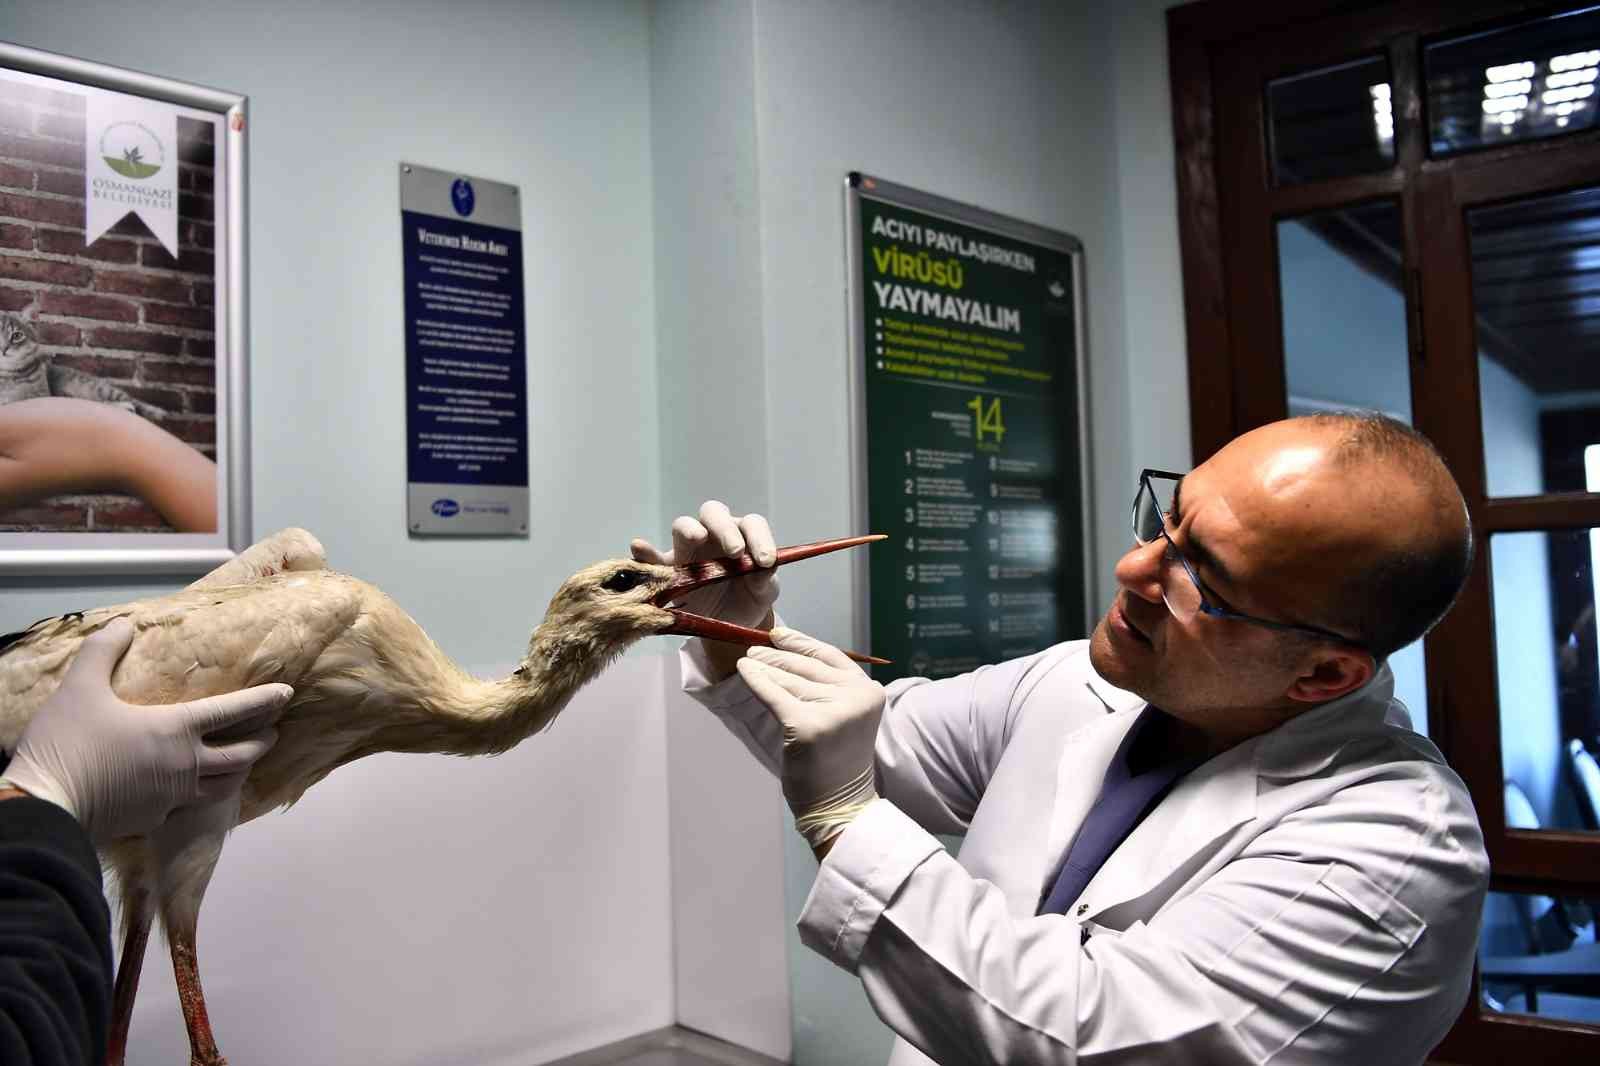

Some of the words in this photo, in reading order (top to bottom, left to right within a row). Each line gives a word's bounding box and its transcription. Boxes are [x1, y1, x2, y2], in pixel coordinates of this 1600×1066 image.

[872, 216, 921, 244] ACIYI
[925, 230, 1035, 272] PAYLAŞIRKEN
[873, 245, 963, 289] VİRÜSÜ
[873, 282, 1020, 332] YAYMAYALIM
[968, 395, 1006, 442] 14
[904, 451, 913, 466] 1
[904, 479, 913, 495] 2
[904, 507, 914, 523] 3
[905, 536, 914, 552] 4
[905, 565, 915, 582] 5
[905, 594, 915, 610] 6
